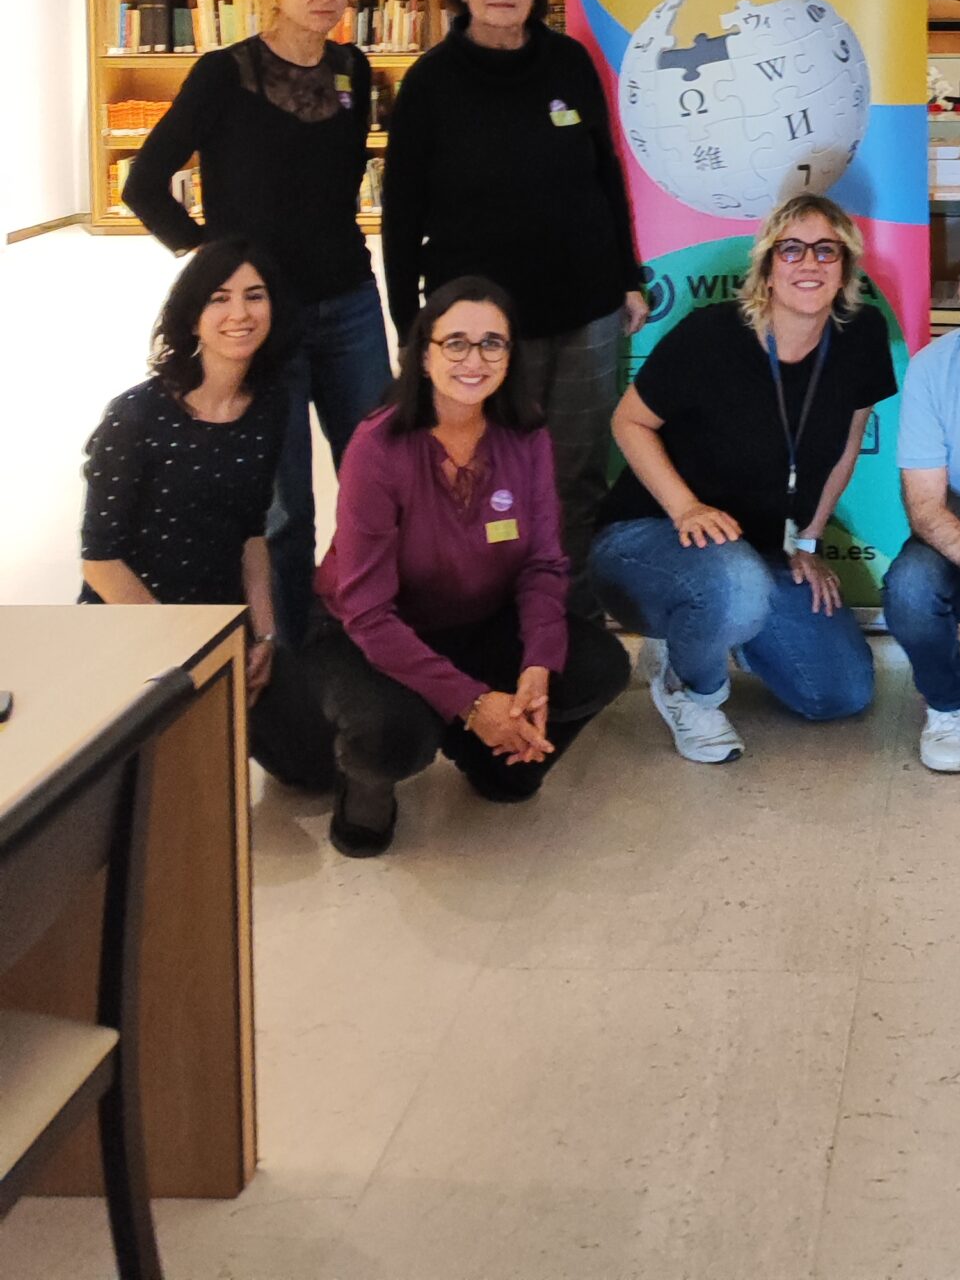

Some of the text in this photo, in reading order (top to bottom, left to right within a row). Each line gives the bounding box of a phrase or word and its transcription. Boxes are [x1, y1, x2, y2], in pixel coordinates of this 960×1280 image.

[753, 55, 786, 81] W
[678, 88, 709, 118] Ω
[825, 545, 876, 561] a.es
